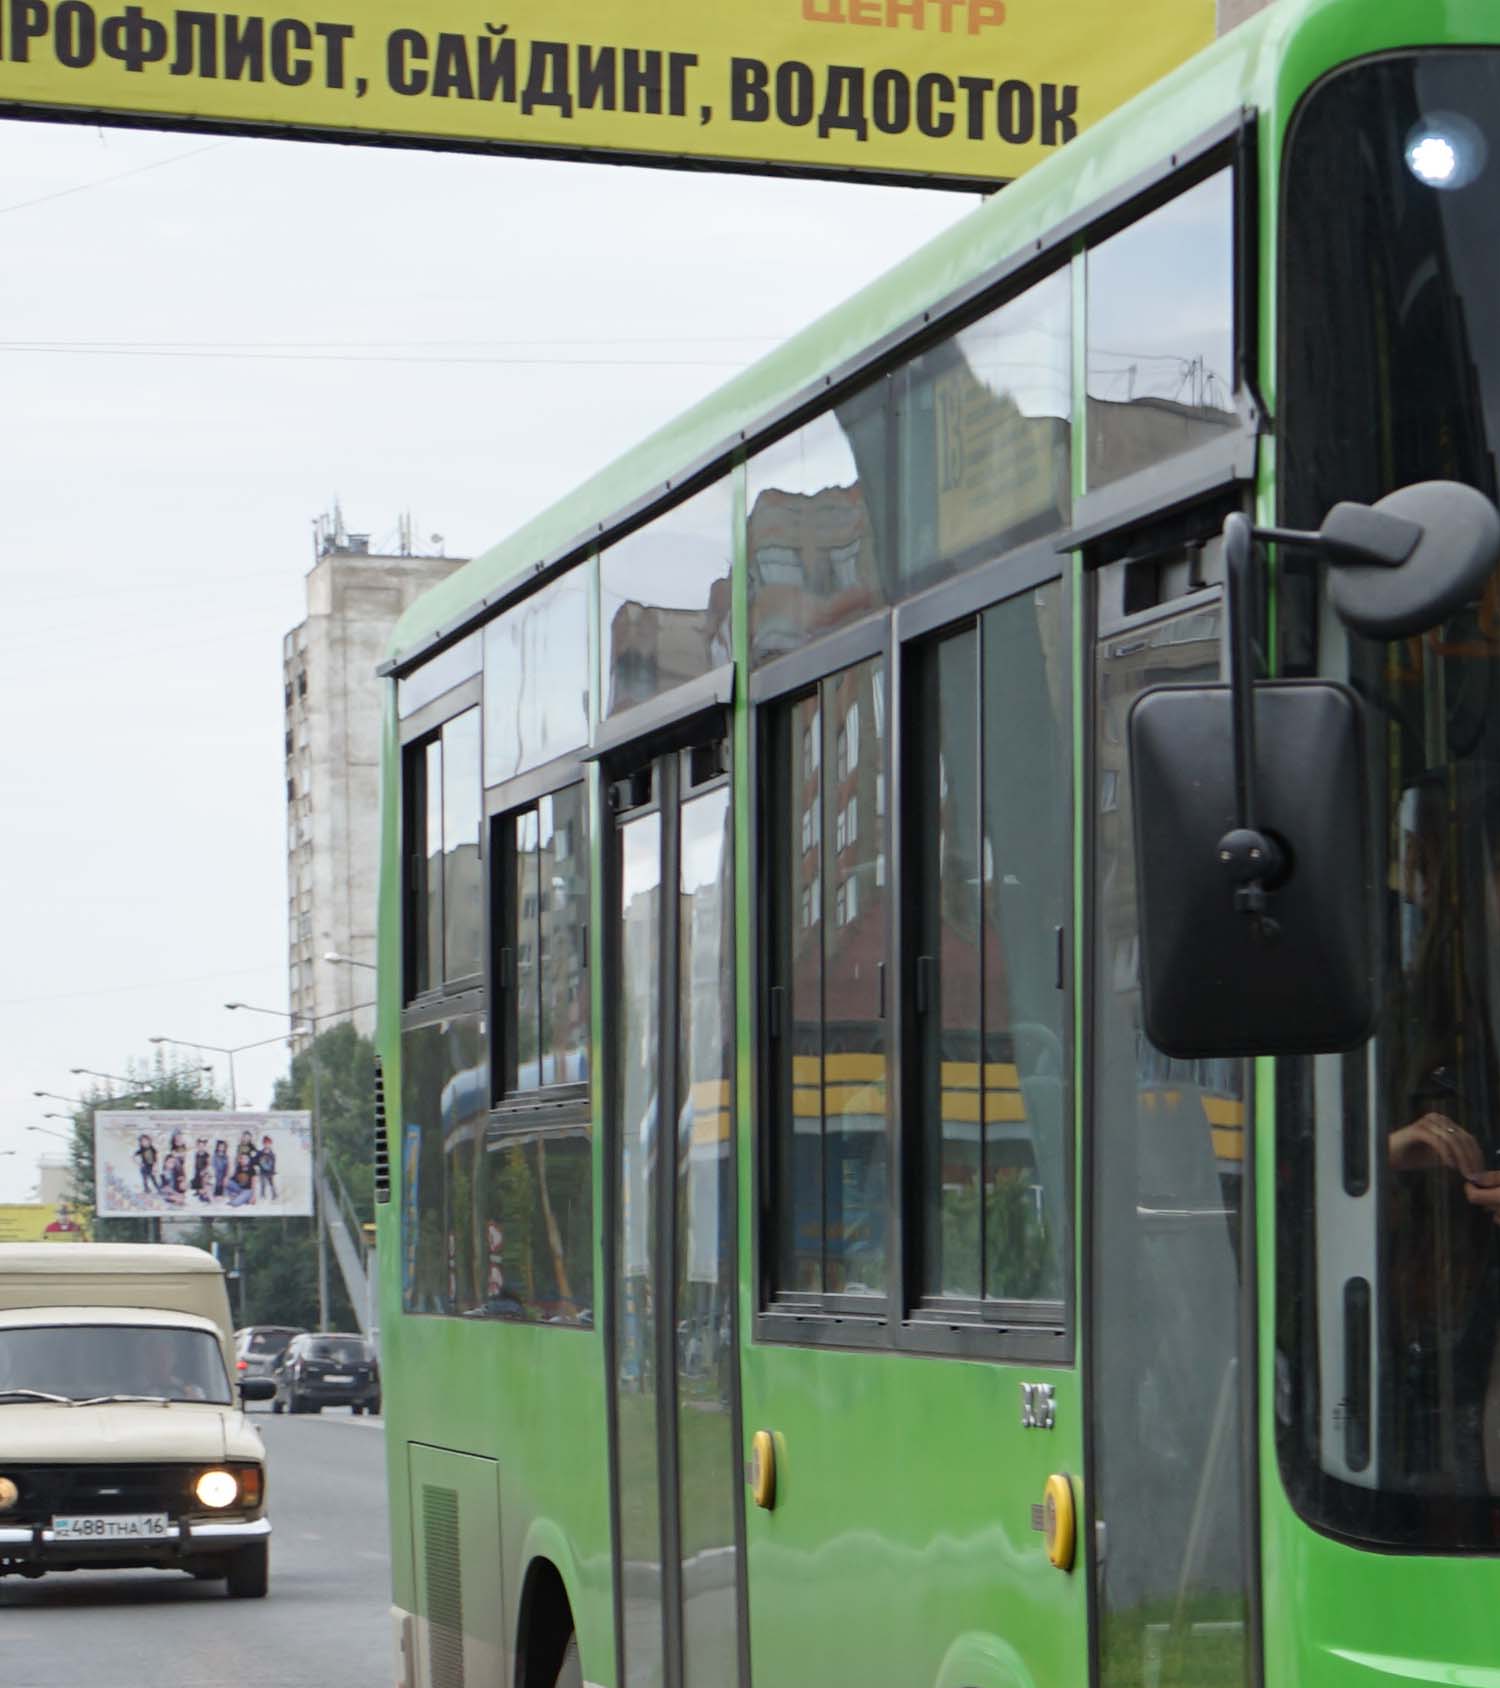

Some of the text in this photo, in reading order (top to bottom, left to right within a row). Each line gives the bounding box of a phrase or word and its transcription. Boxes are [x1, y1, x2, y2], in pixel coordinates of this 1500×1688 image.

[0, 0, 1079, 147] РОФЛИСТ, САЙДИНГ, ВОДОСТОК
[143, 1518, 164, 1534] 16
